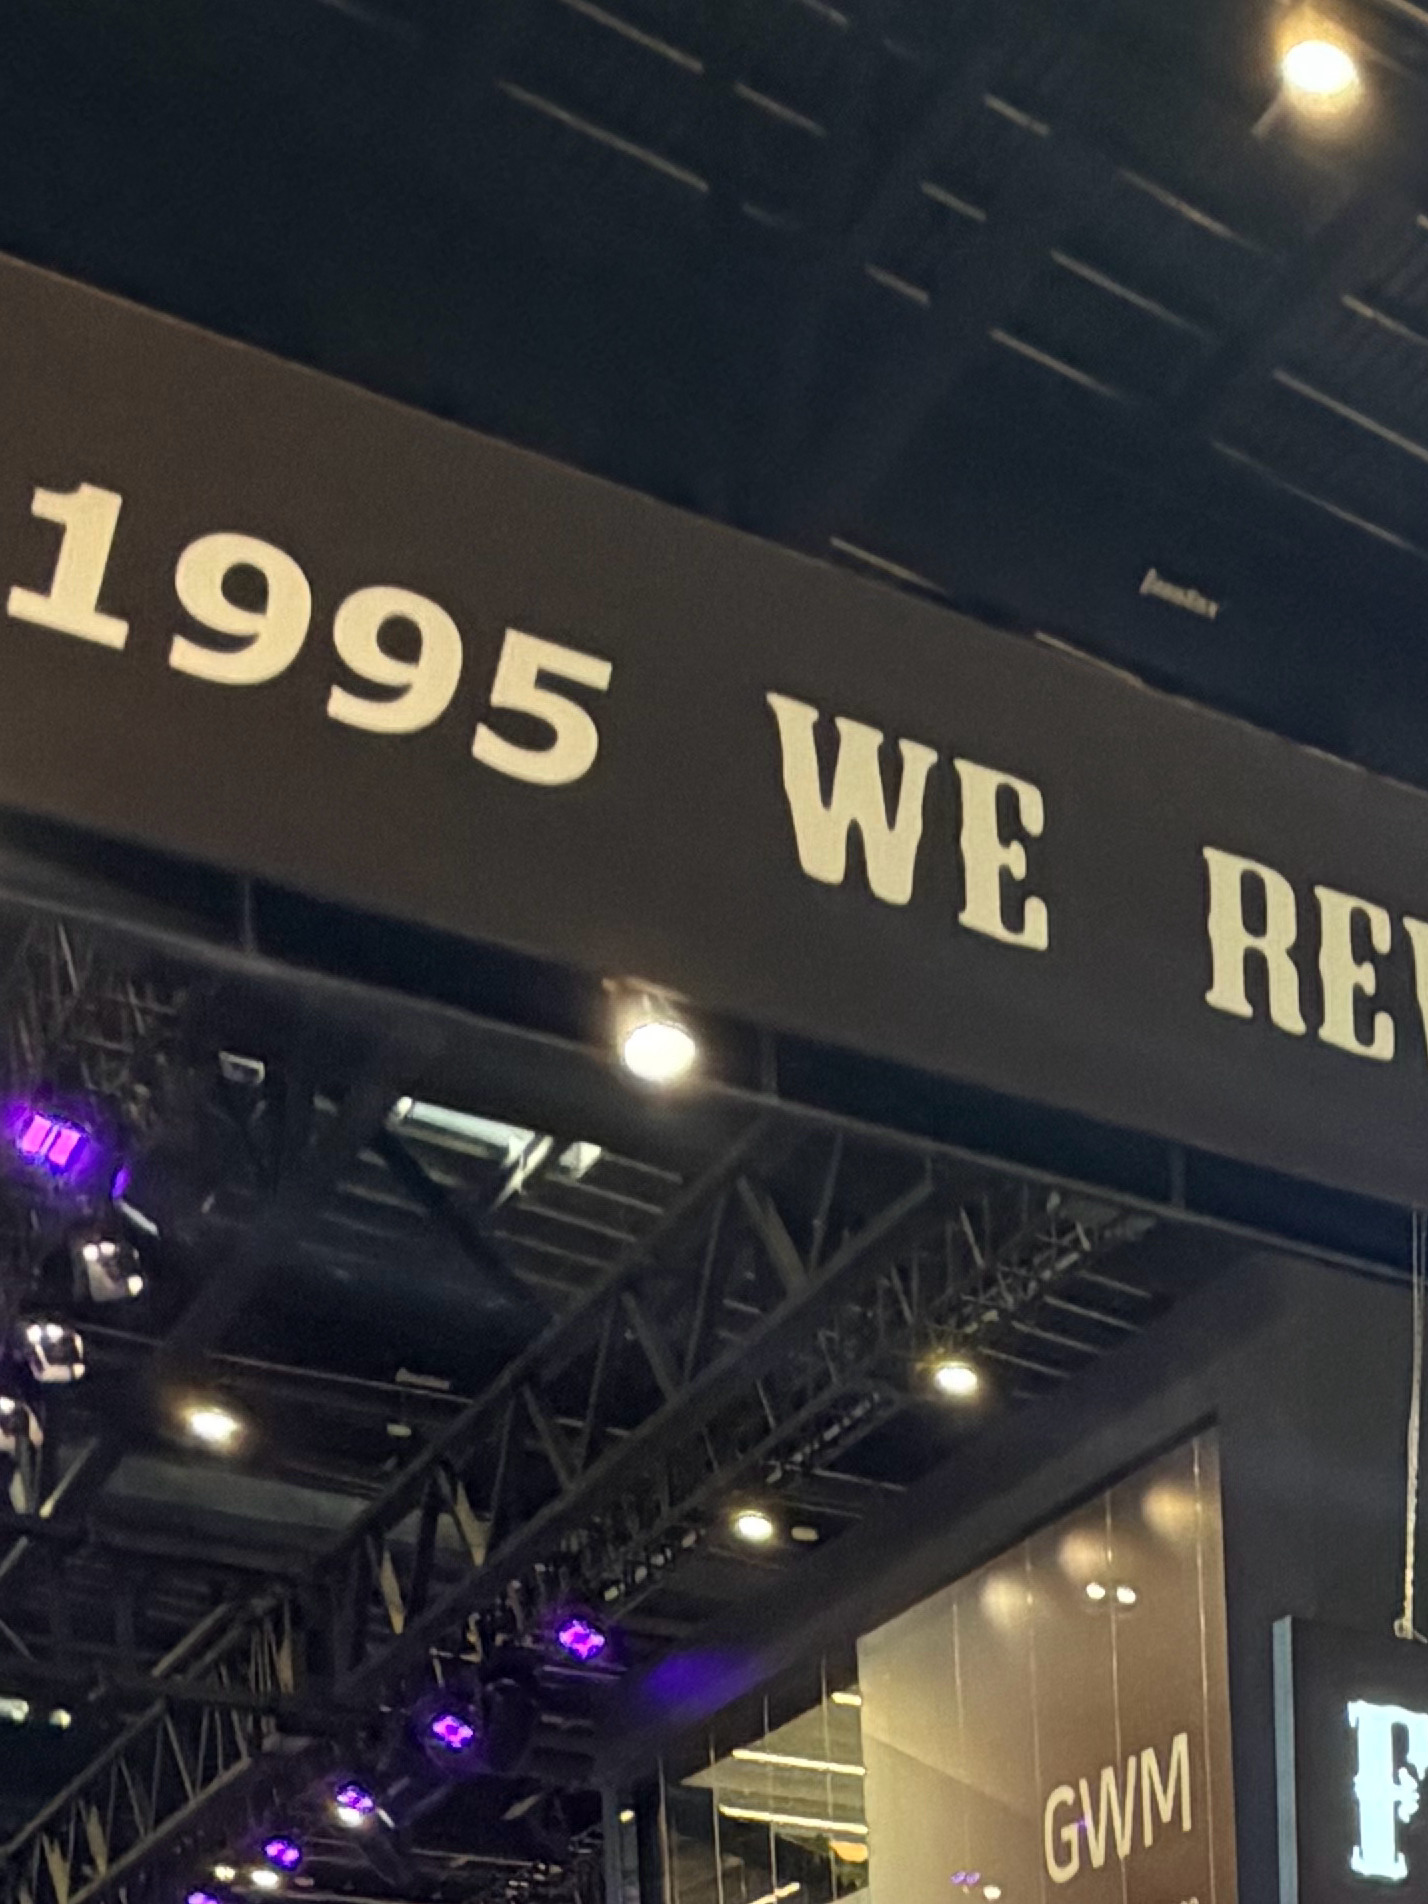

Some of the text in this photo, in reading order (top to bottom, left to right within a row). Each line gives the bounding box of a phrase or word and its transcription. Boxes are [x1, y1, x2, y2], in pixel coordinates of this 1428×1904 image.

[6, 482, 612, 786] 1995
[766, 692, 1049, 951] WE
[1045, 1732, 1192, 1884] GWM
